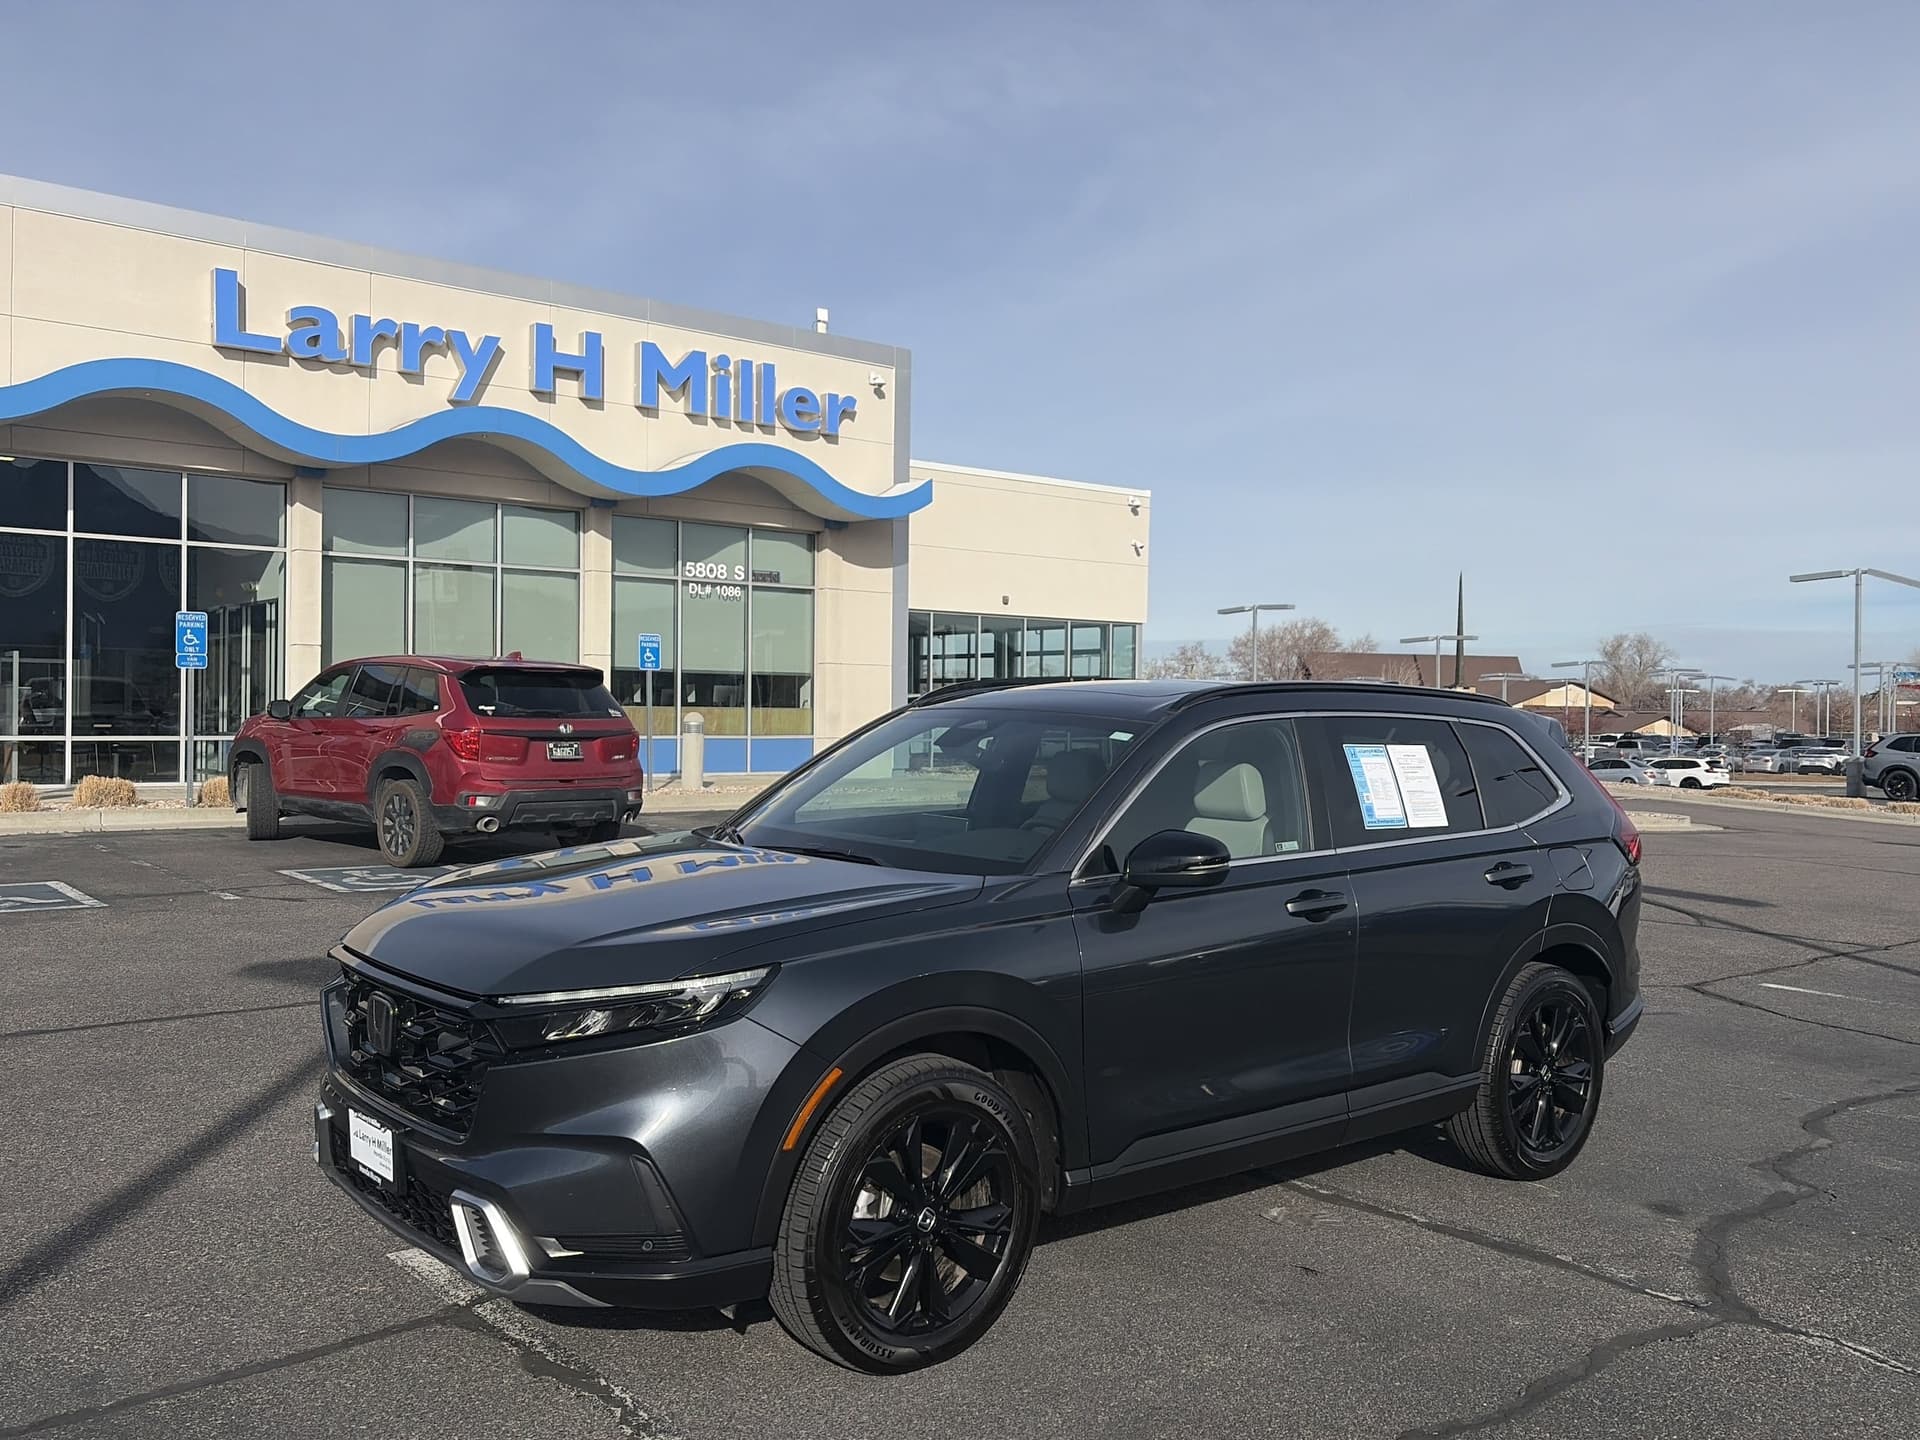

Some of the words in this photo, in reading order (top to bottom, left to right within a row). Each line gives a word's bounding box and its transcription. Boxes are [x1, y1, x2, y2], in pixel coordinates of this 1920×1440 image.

[212, 268, 501, 401] Larry
[530, 322, 602, 400] H
[635, 341, 858, 436] Miller
[685, 562, 728, 579] 5808
[734, 566, 745, 580] S
[688, 583, 712, 595] DL#
[716, 585, 742, 597] 1086
[177, 613, 206, 621] RESERVED
[179, 621, 205, 629] PARKING
[359, 1128, 371, 1147] Larry
